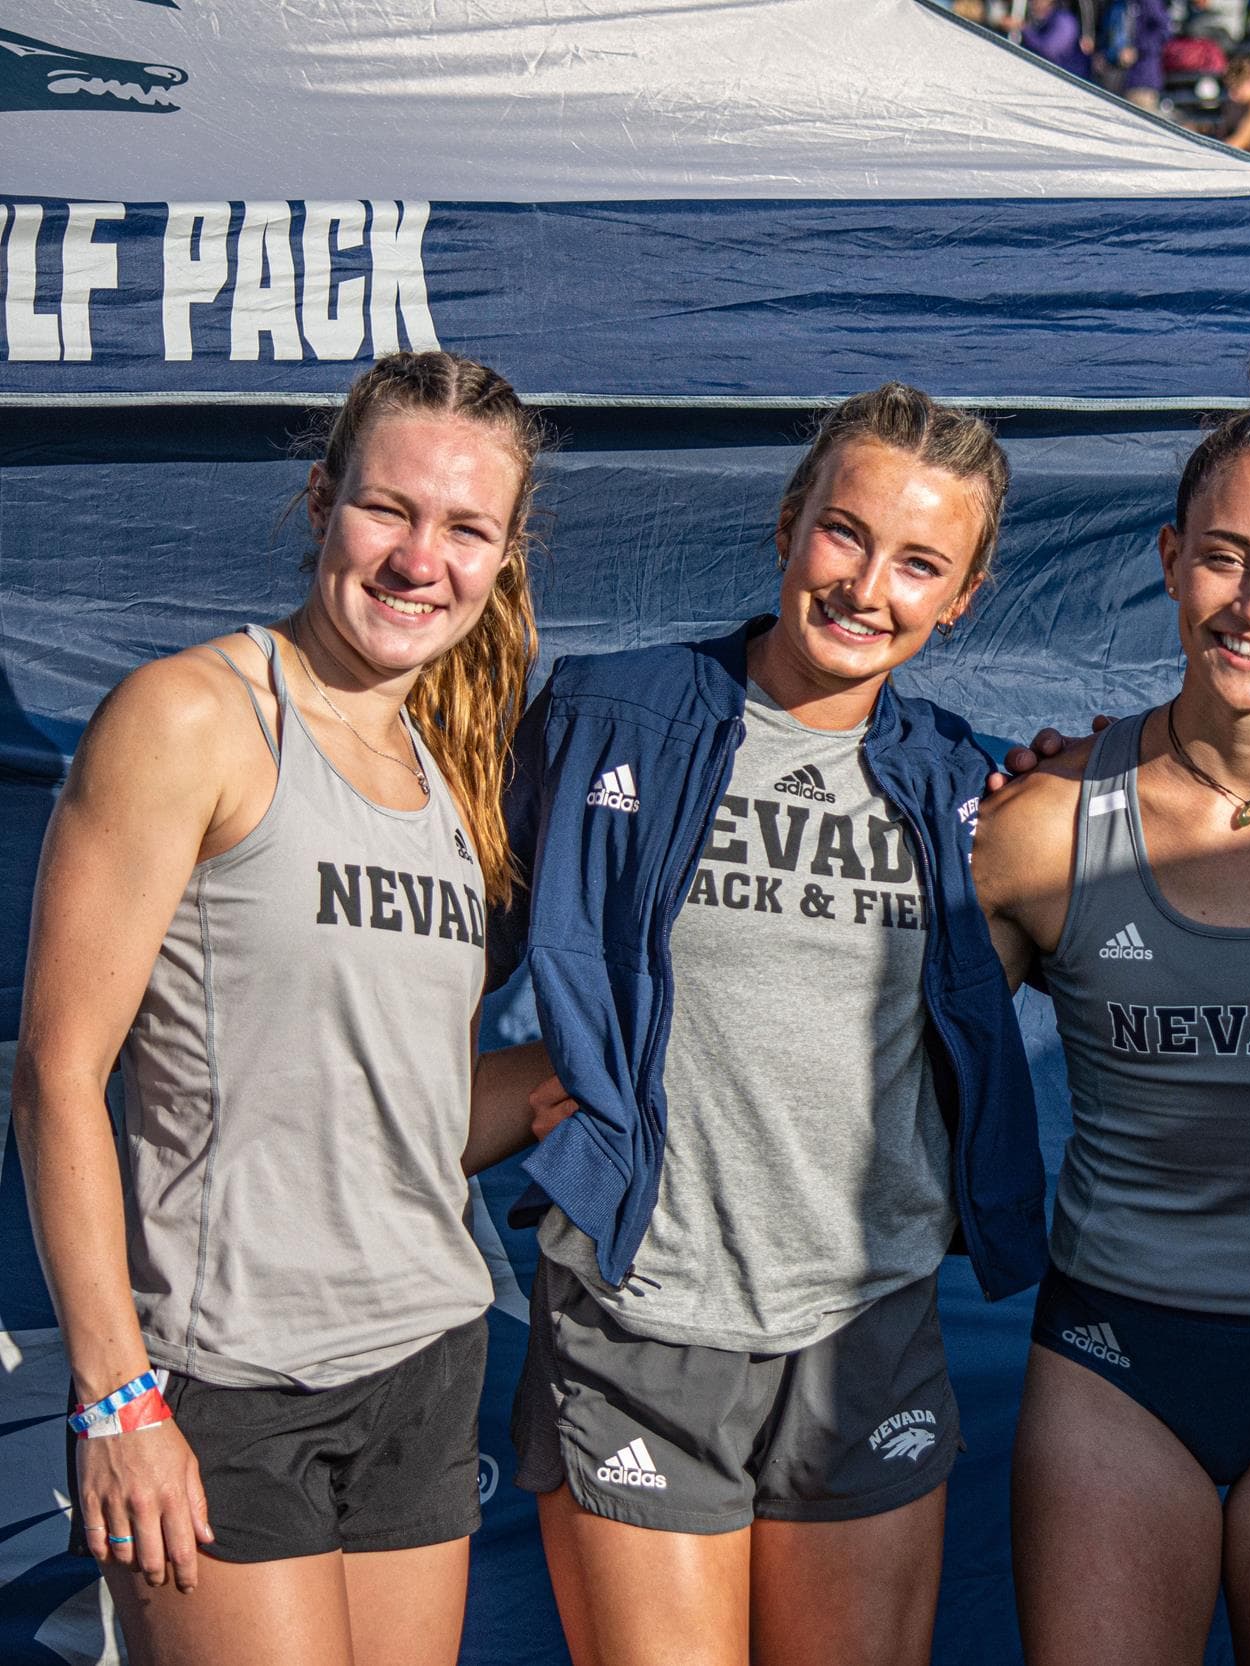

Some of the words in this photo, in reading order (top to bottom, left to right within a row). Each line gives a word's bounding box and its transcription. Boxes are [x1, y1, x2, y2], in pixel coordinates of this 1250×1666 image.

[0, 203, 126, 361] LF
[162, 200, 442, 361] PACK
[587, 788, 640, 812] adidas
[774, 780, 836, 804] adidas
[799, 883, 836, 920] &
[1099, 945, 1153, 960] adidas
[1062, 1327, 1131, 1369] adidas
[869, 1409, 936, 1451] NEVADA
[597, 1464, 668, 1489] adidas
